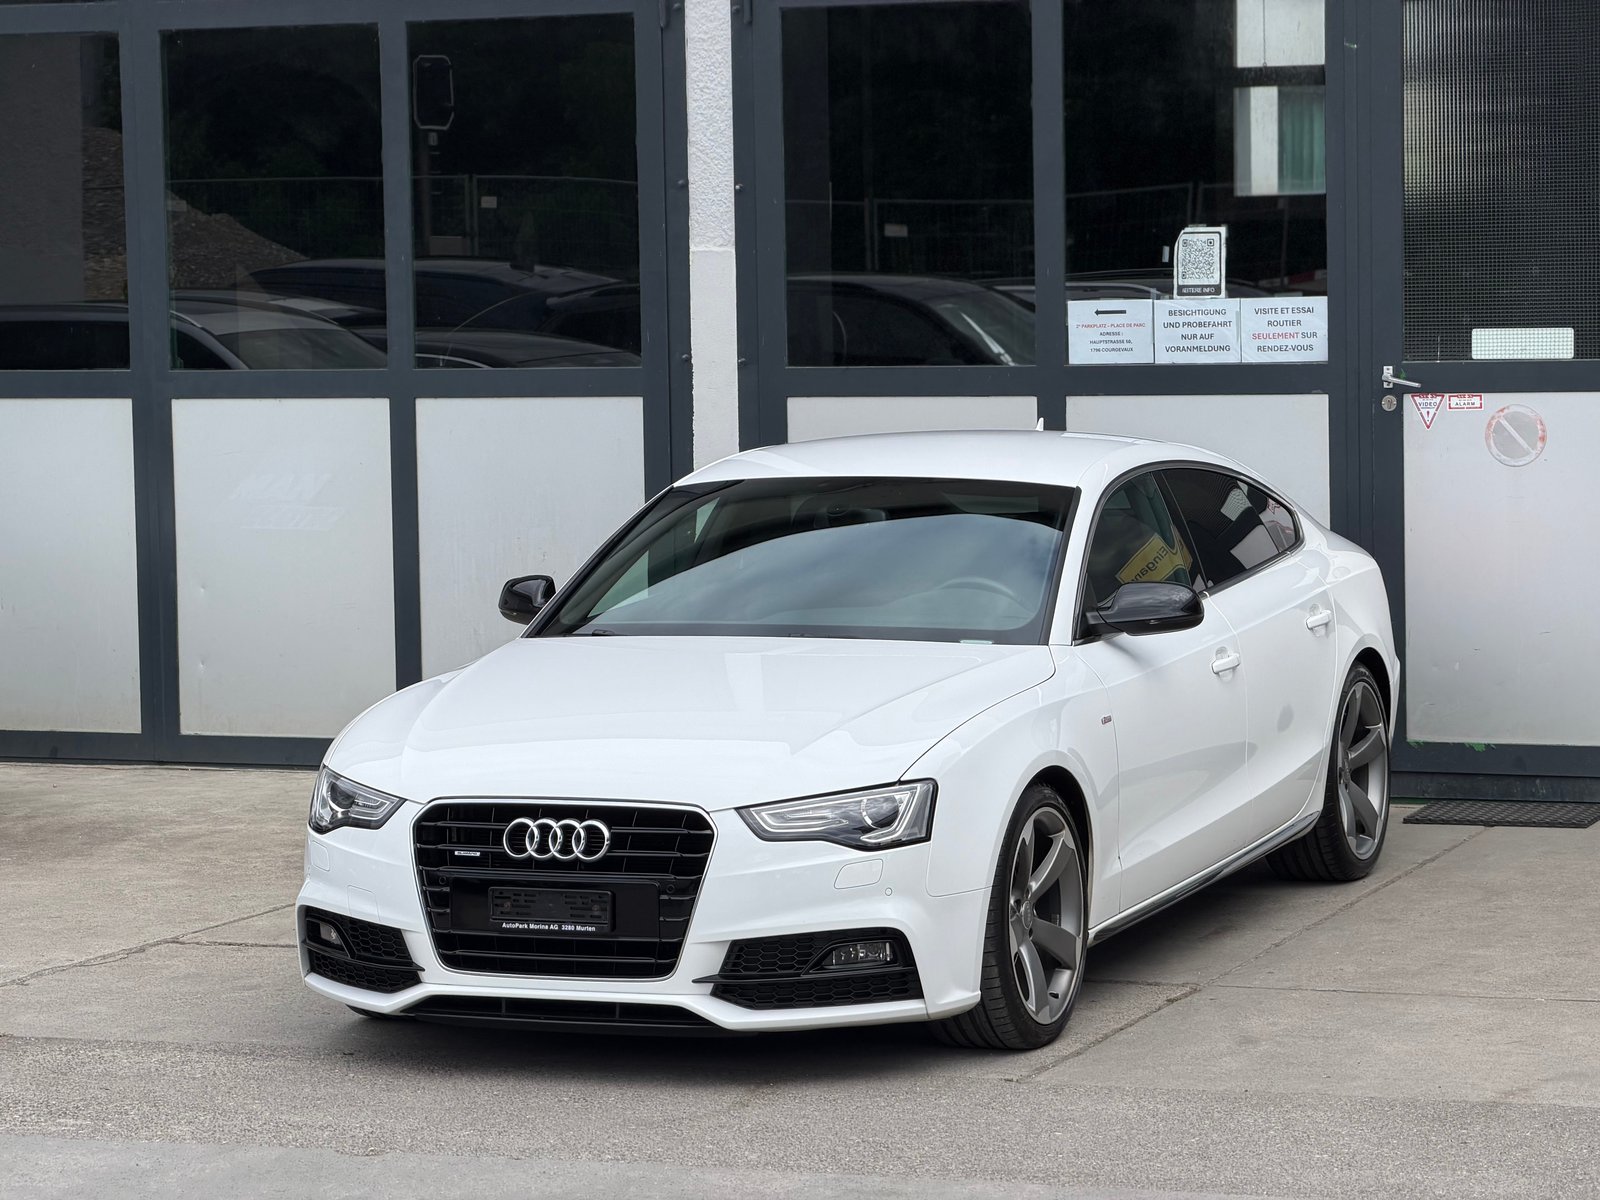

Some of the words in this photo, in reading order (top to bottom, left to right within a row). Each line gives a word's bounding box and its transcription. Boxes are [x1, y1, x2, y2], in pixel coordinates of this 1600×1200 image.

[1168, 308, 1227, 317] BESICHTIGUNG
[1254, 307, 1279, 315] VISITE
[1291, 306, 1314, 314] ESSAI
[1163, 321, 1181, 329] UND
[1182, 320, 1232, 328] PROBEFAHRT
[1267, 319, 1302, 327] ROUTIER
[1252, 332, 1300, 340] SEULEMENT
[1301, 331, 1318, 339] SUR
[1165, 344, 1231, 353] VORANMELDUNG
[1257, 344, 1314, 353] RENDEZ-VOUS
